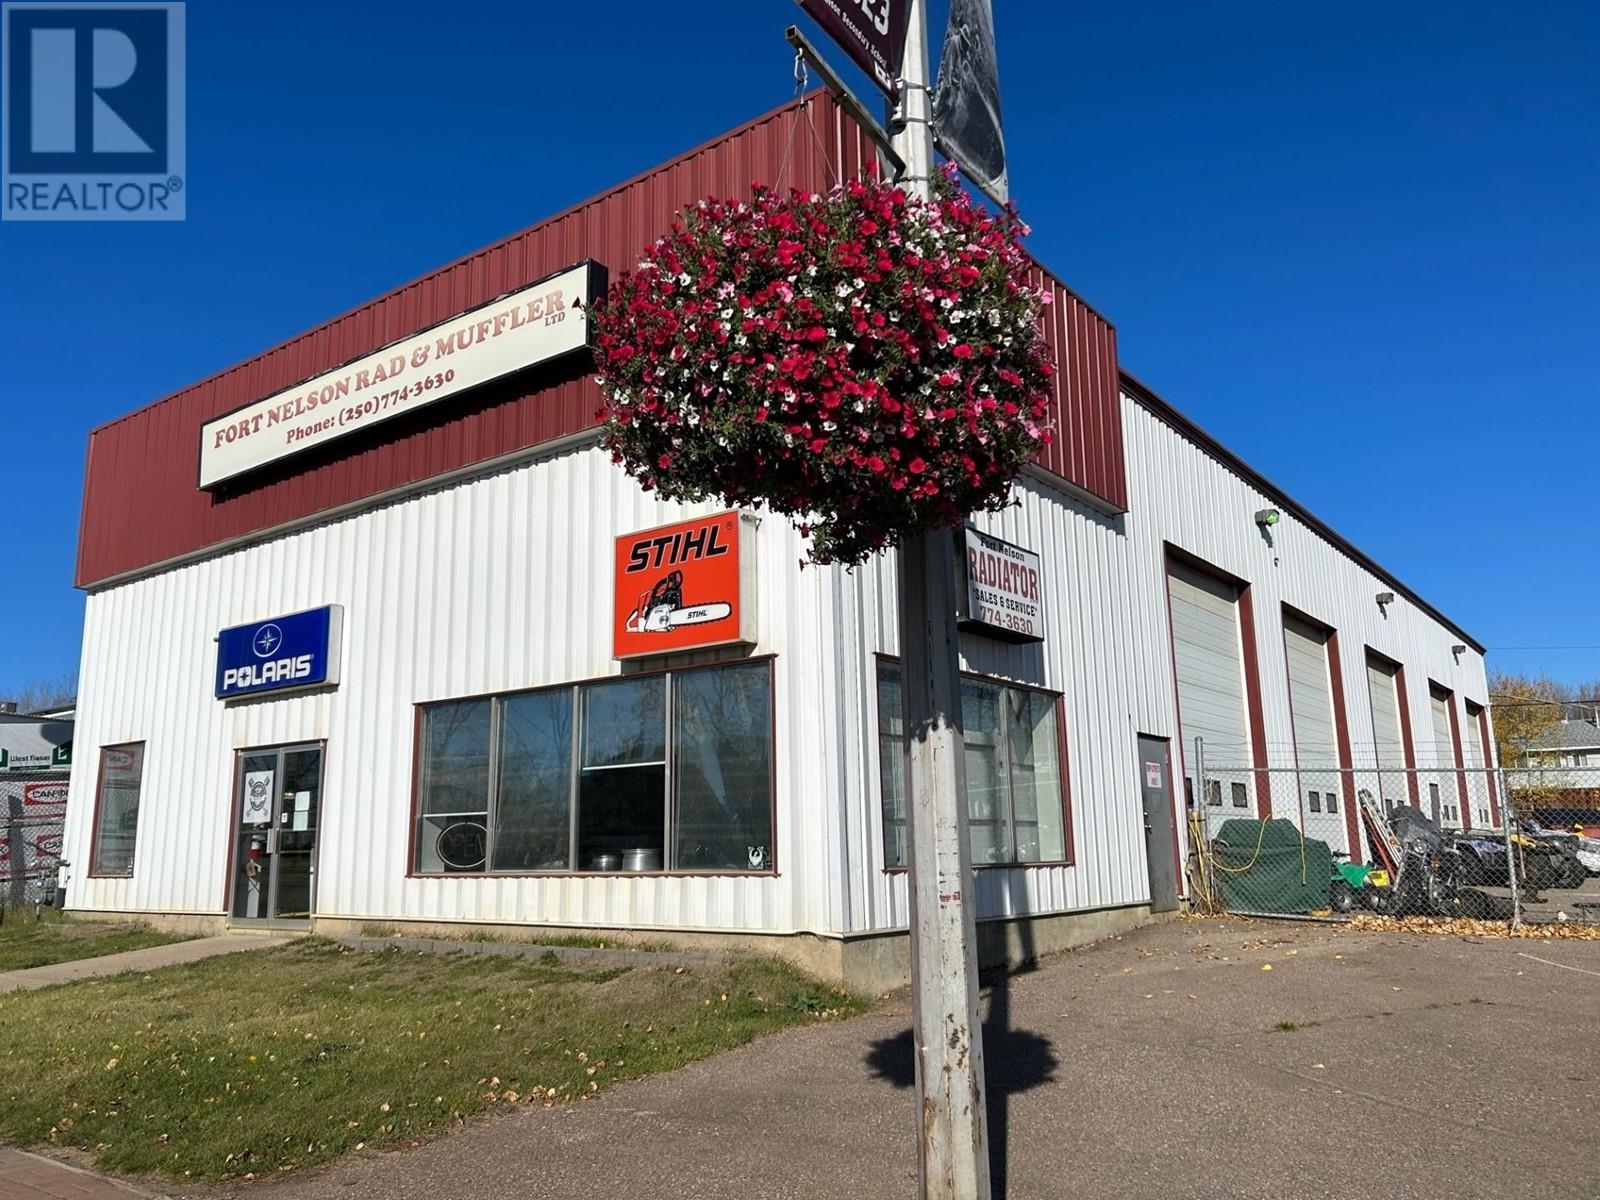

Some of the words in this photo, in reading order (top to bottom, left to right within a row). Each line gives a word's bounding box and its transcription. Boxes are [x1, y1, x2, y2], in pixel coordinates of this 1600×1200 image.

[544, 311, 566, 327] LTD
[214, 413, 264, 448] FORT
[267, 376, 351, 427] NELSON
[355, 354, 406, 391] RAD
[411, 344, 430, 368] &
[435, 290, 566, 360] MUFFLER
[286, 417, 335, 444] Phone:
[339, 369, 455, 426] (250)774-3630
[625, 524, 729, 574] STIHL
[980, 537, 997, 551] Fort
[998, 544, 1025, 561] Nelson
[968, 546, 1039, 601] RADIATOR
[687, 609, 708, 619] STIHL
[1000, 596, 1005, 608] &
[980, 605, 1033, 635] 774-3630
[223, 654, 312, 690] POLARIS
[10, 754, 29, 762] West
